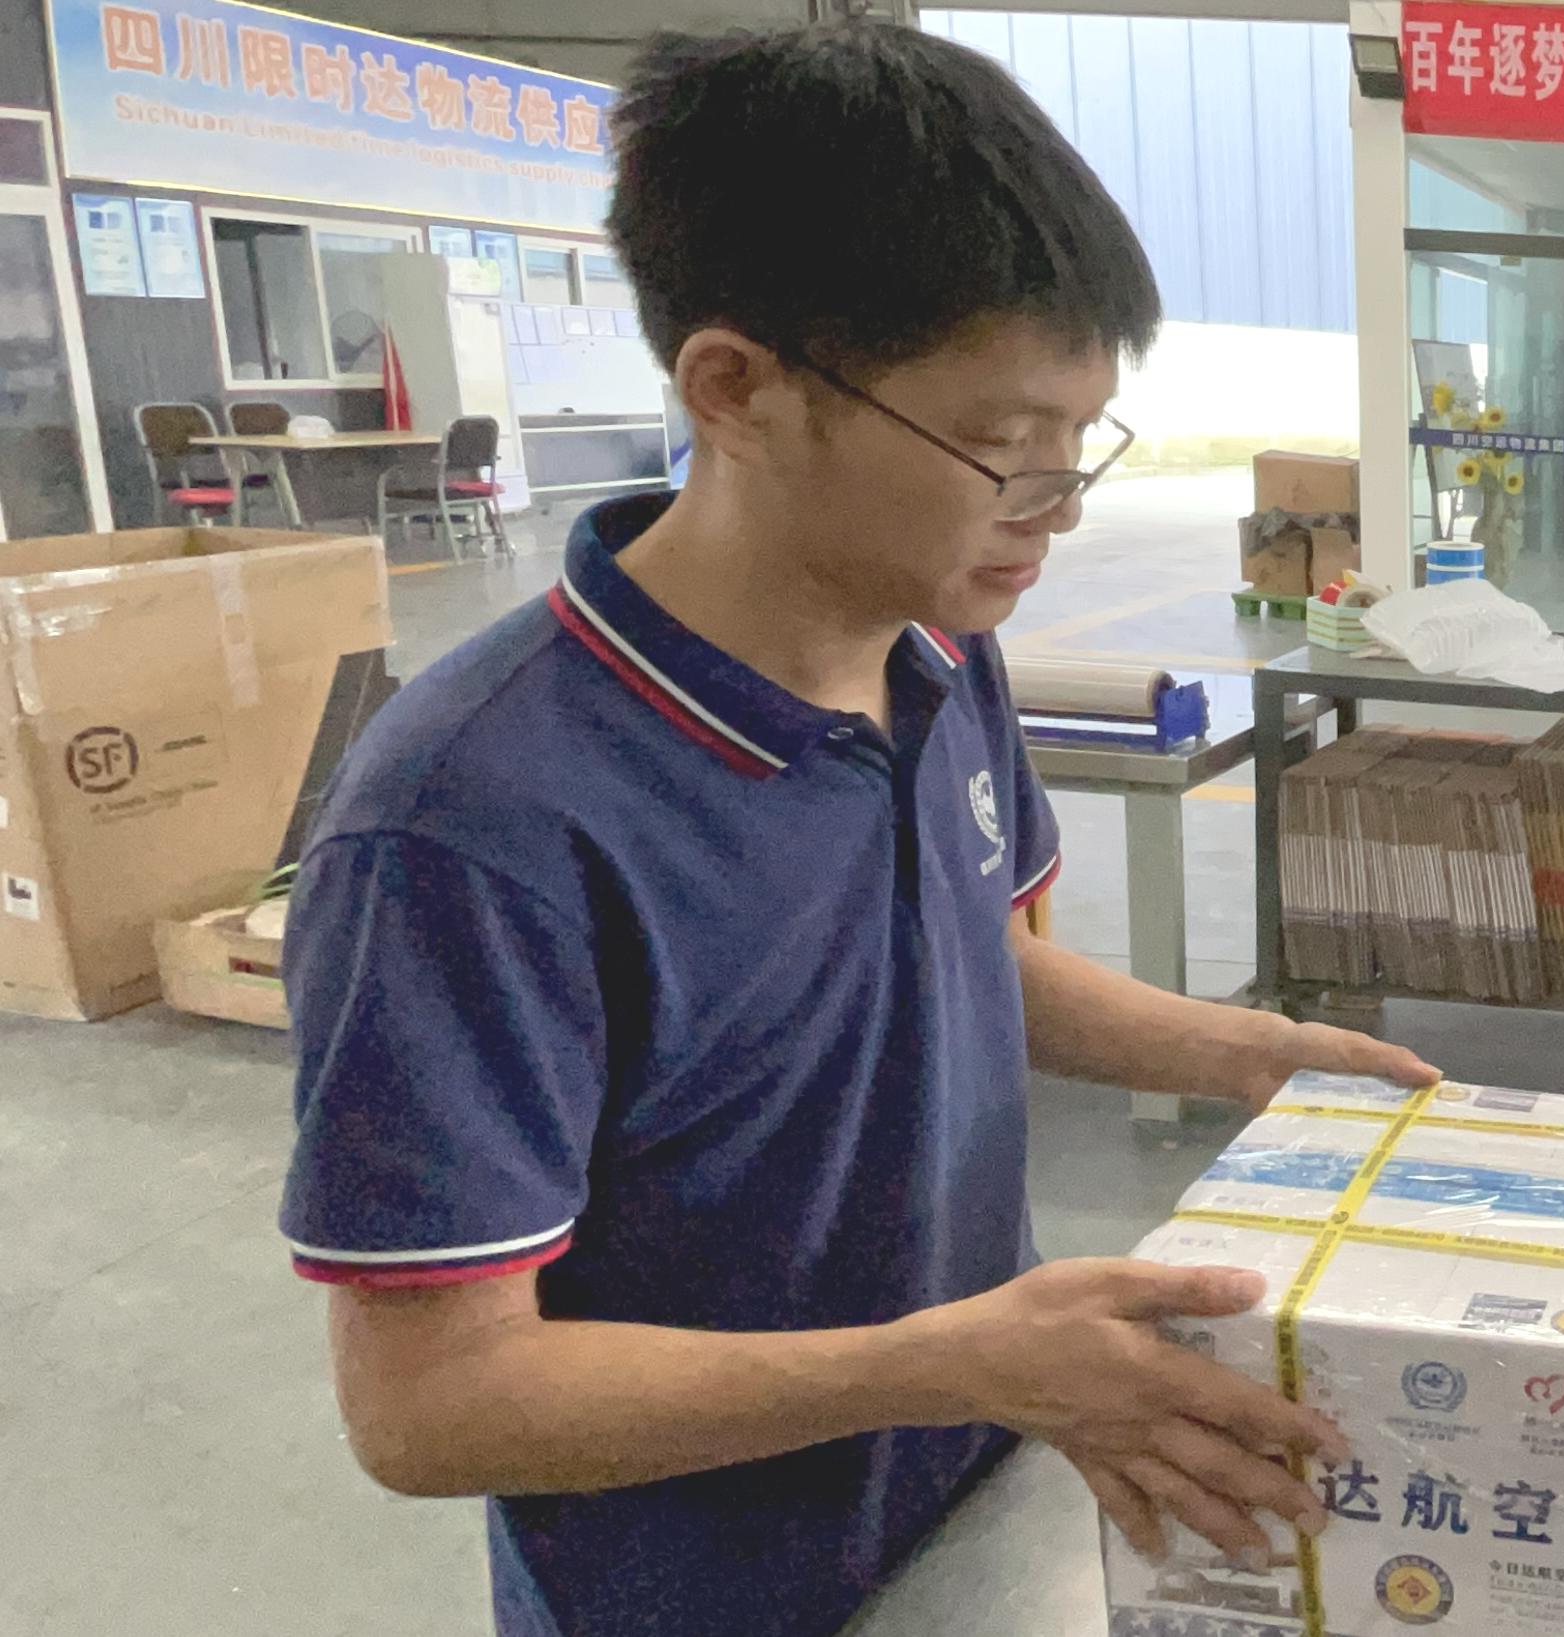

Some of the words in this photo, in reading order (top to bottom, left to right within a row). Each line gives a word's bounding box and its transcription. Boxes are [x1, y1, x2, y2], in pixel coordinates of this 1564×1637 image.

[103, 3, 603, 155] 四川限时达物流供应
[115, 94, 234, 132] Sichuan
[78, 741, 122, 779] SF
